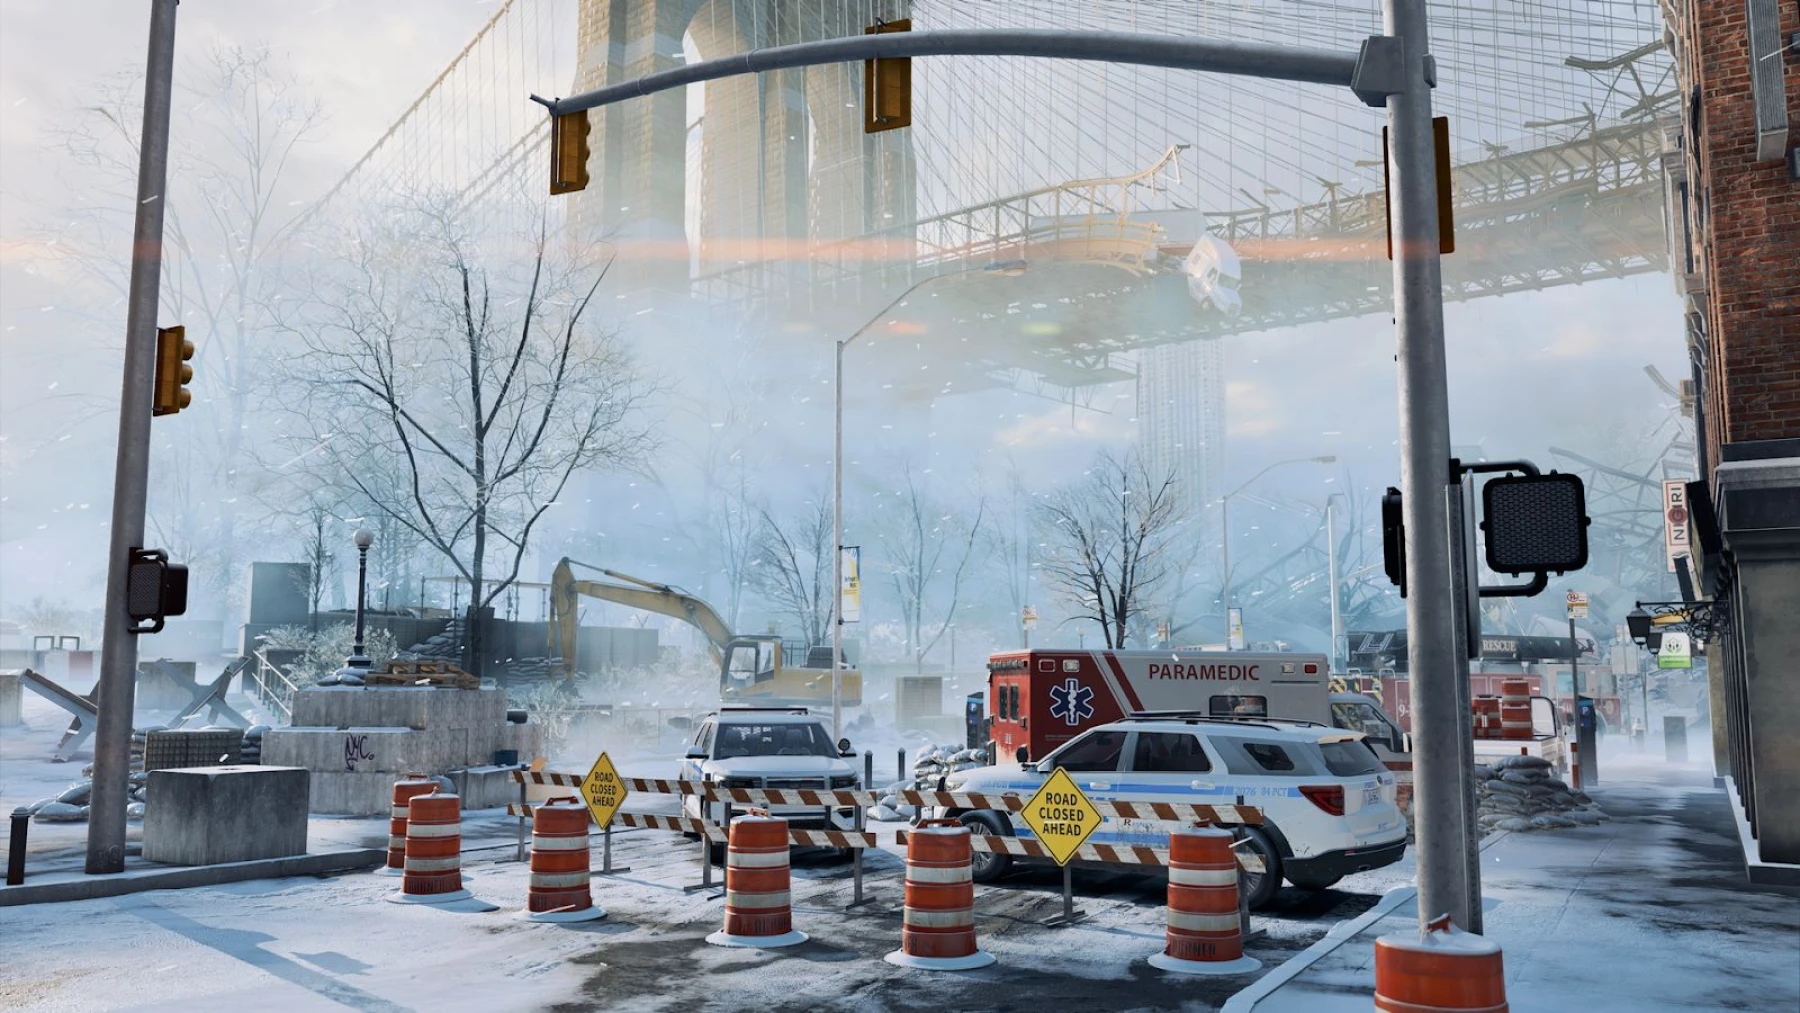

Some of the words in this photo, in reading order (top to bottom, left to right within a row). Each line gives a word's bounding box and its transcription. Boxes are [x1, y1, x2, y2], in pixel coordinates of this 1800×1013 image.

[1670, 486, 1686, 540] NIGIRI
[1482, 640, 1517, 652] RESCUE
[1149, 663, 1260, 681] PARAMEDIC
[594, 771, 614, 783] ROAD
[590, 783, 617, 796] CLOSED
[1272, 787, 1288, 797] PCT
[592, 796, 615, 807] AHEAD
[1045, 792, 1078, 806] ROAD
[1038, 807, 1085, 822] CLOSED
[1042, 823, 1082, 836] AHEAD
